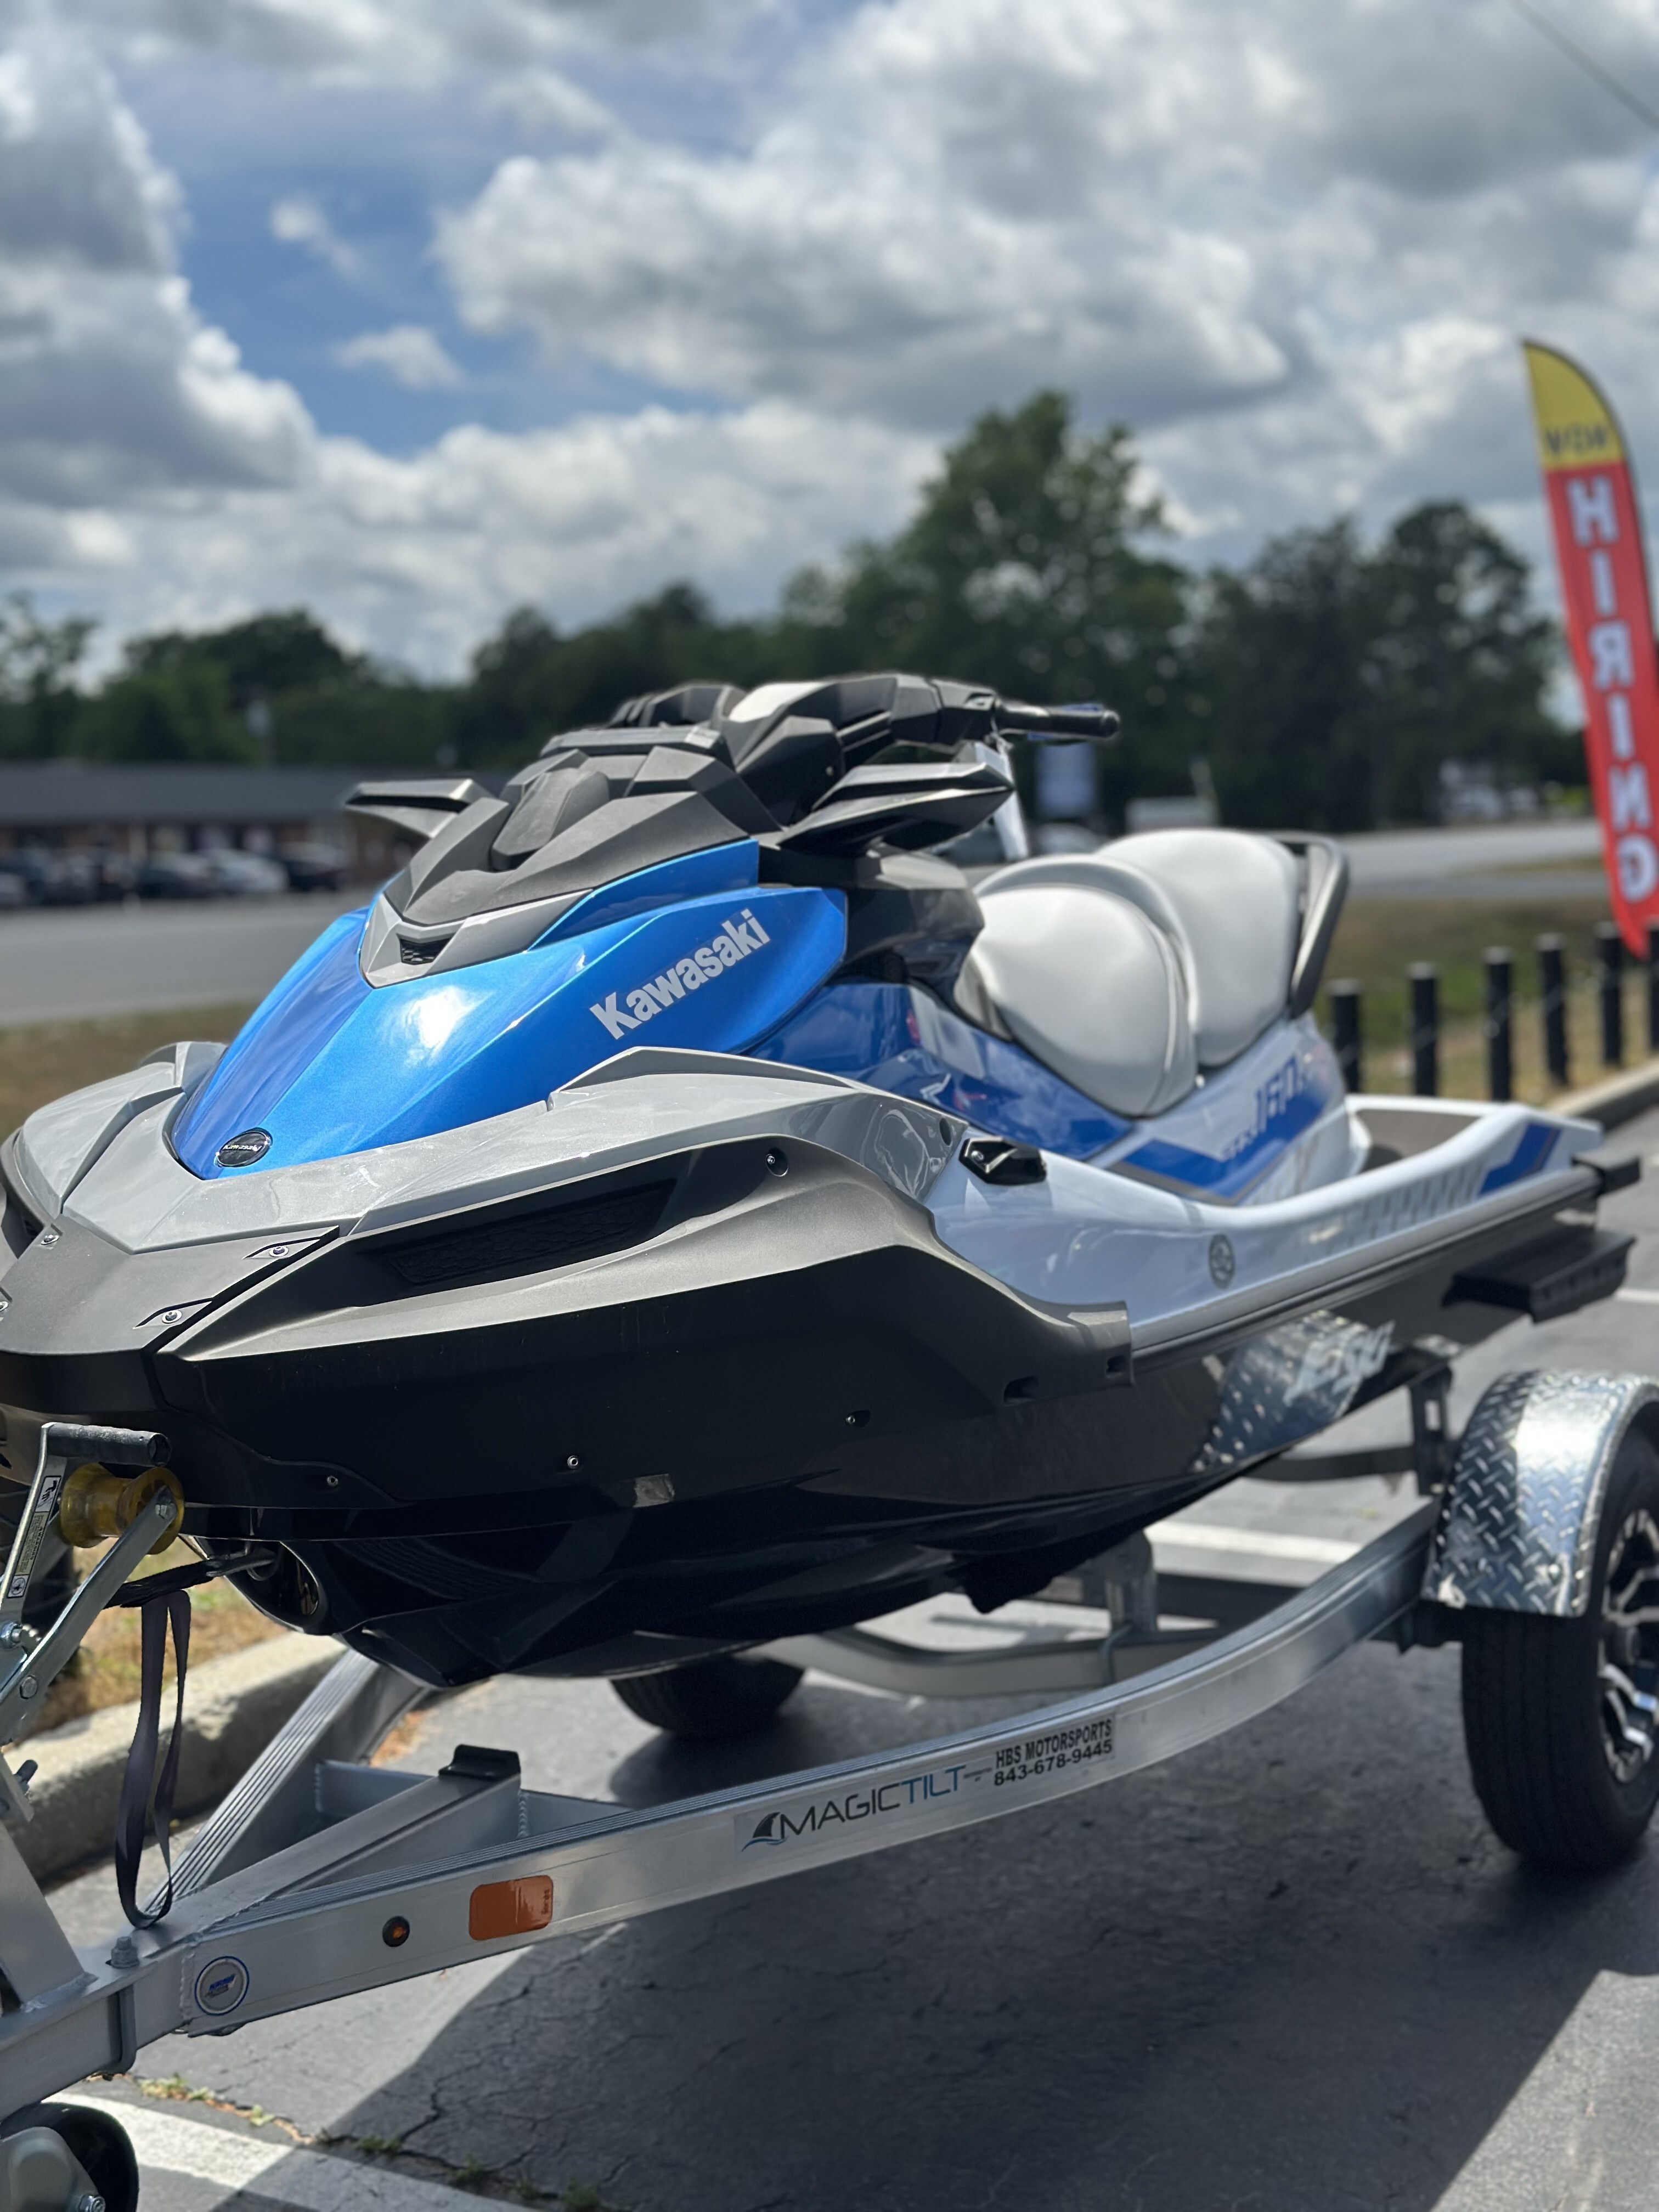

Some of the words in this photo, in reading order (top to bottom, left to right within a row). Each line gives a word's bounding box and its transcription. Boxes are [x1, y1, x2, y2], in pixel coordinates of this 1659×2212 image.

[589, 908, 770, 1040] Kawasaki
[994, 1739, 1113, 1786] 843-678-9445
[995, 1745, 1022, 1769] HBS
[1025, 1719, 1113, 1761] MOTORSPORTS
[780, 1764, 967, 1840] MAGICTILT
